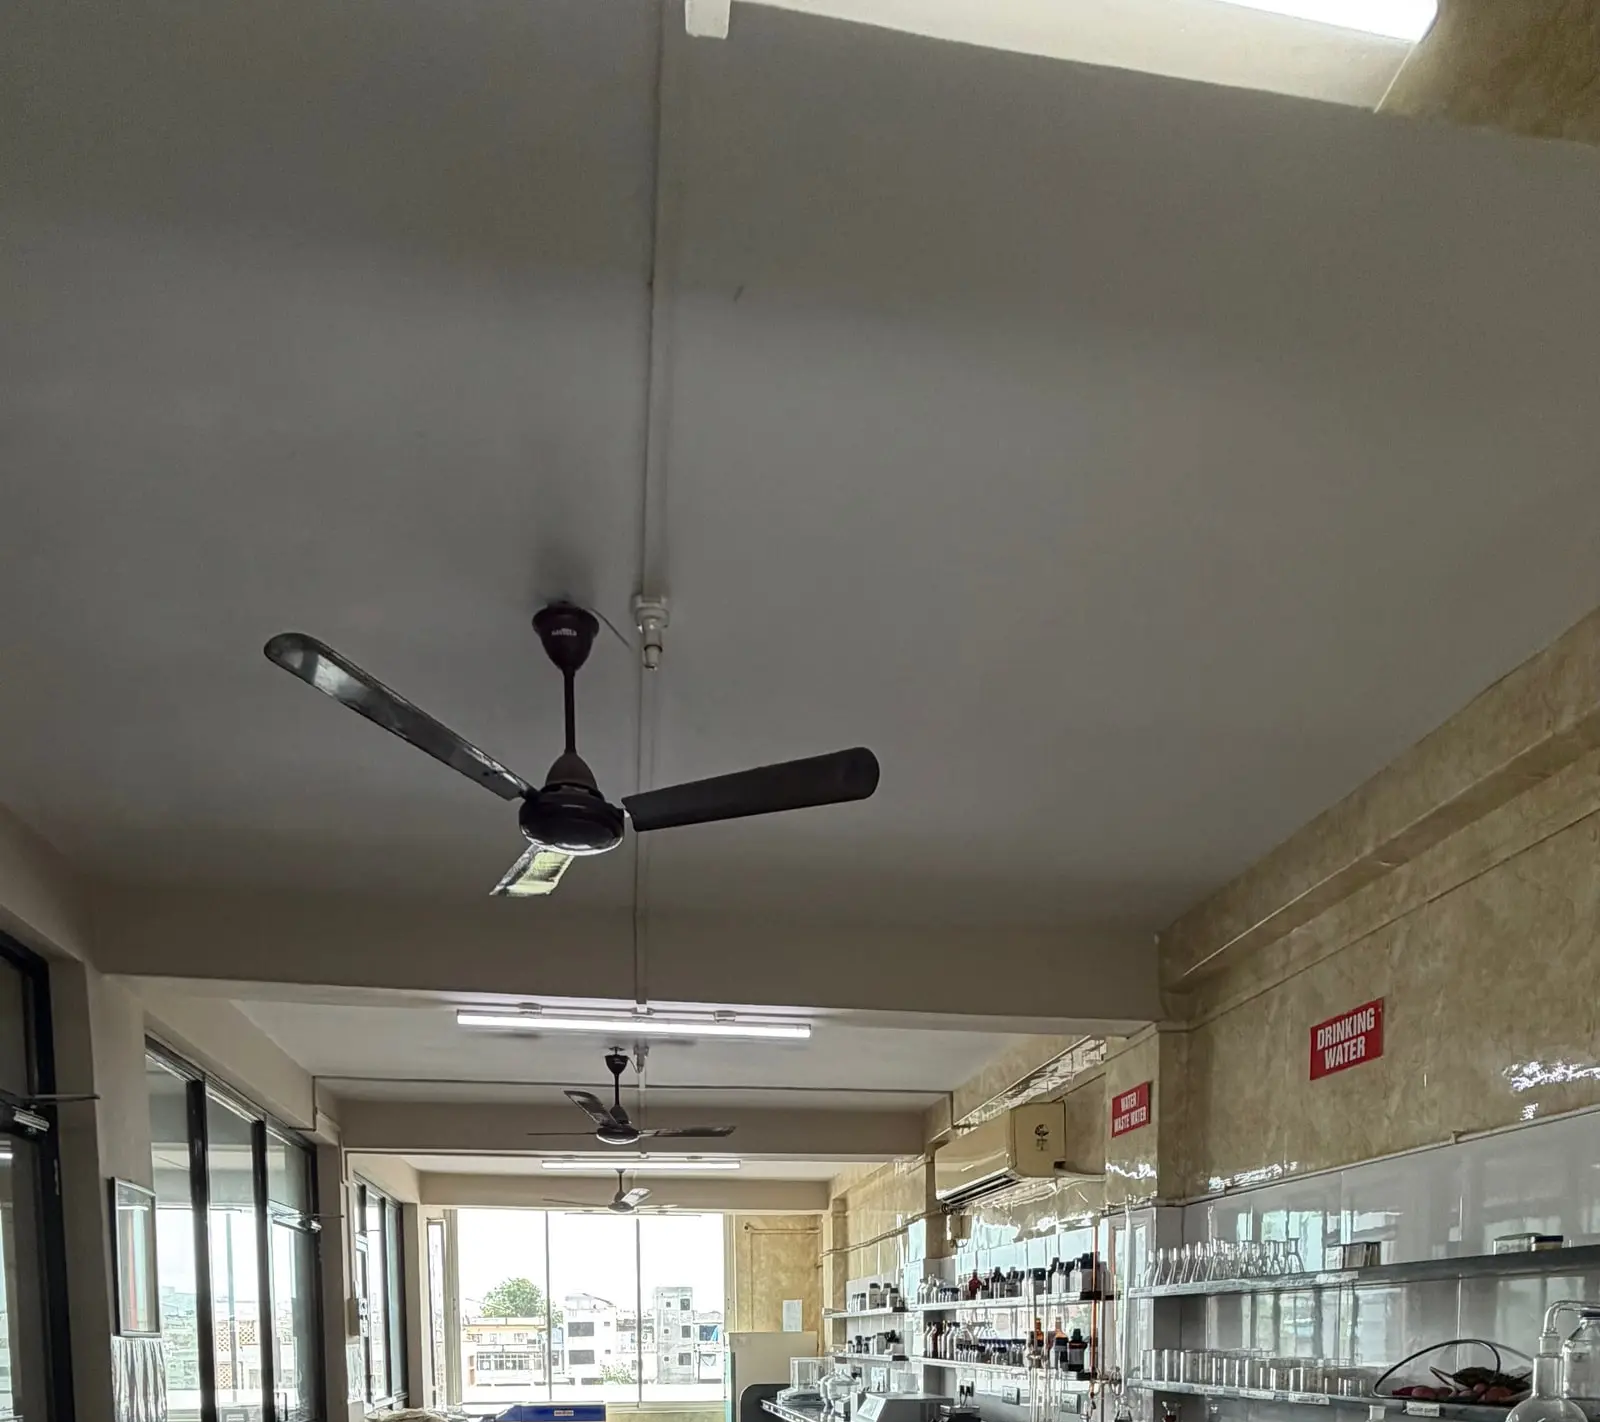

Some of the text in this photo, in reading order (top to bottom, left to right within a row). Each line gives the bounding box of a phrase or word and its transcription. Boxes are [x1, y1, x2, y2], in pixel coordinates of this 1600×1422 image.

[1316, 1007, 1375, 1051] DRINKING
[1324, 1035, 1366, 1070] WATER
[1113, 1105, 1147, 1132] WASTE WATER
